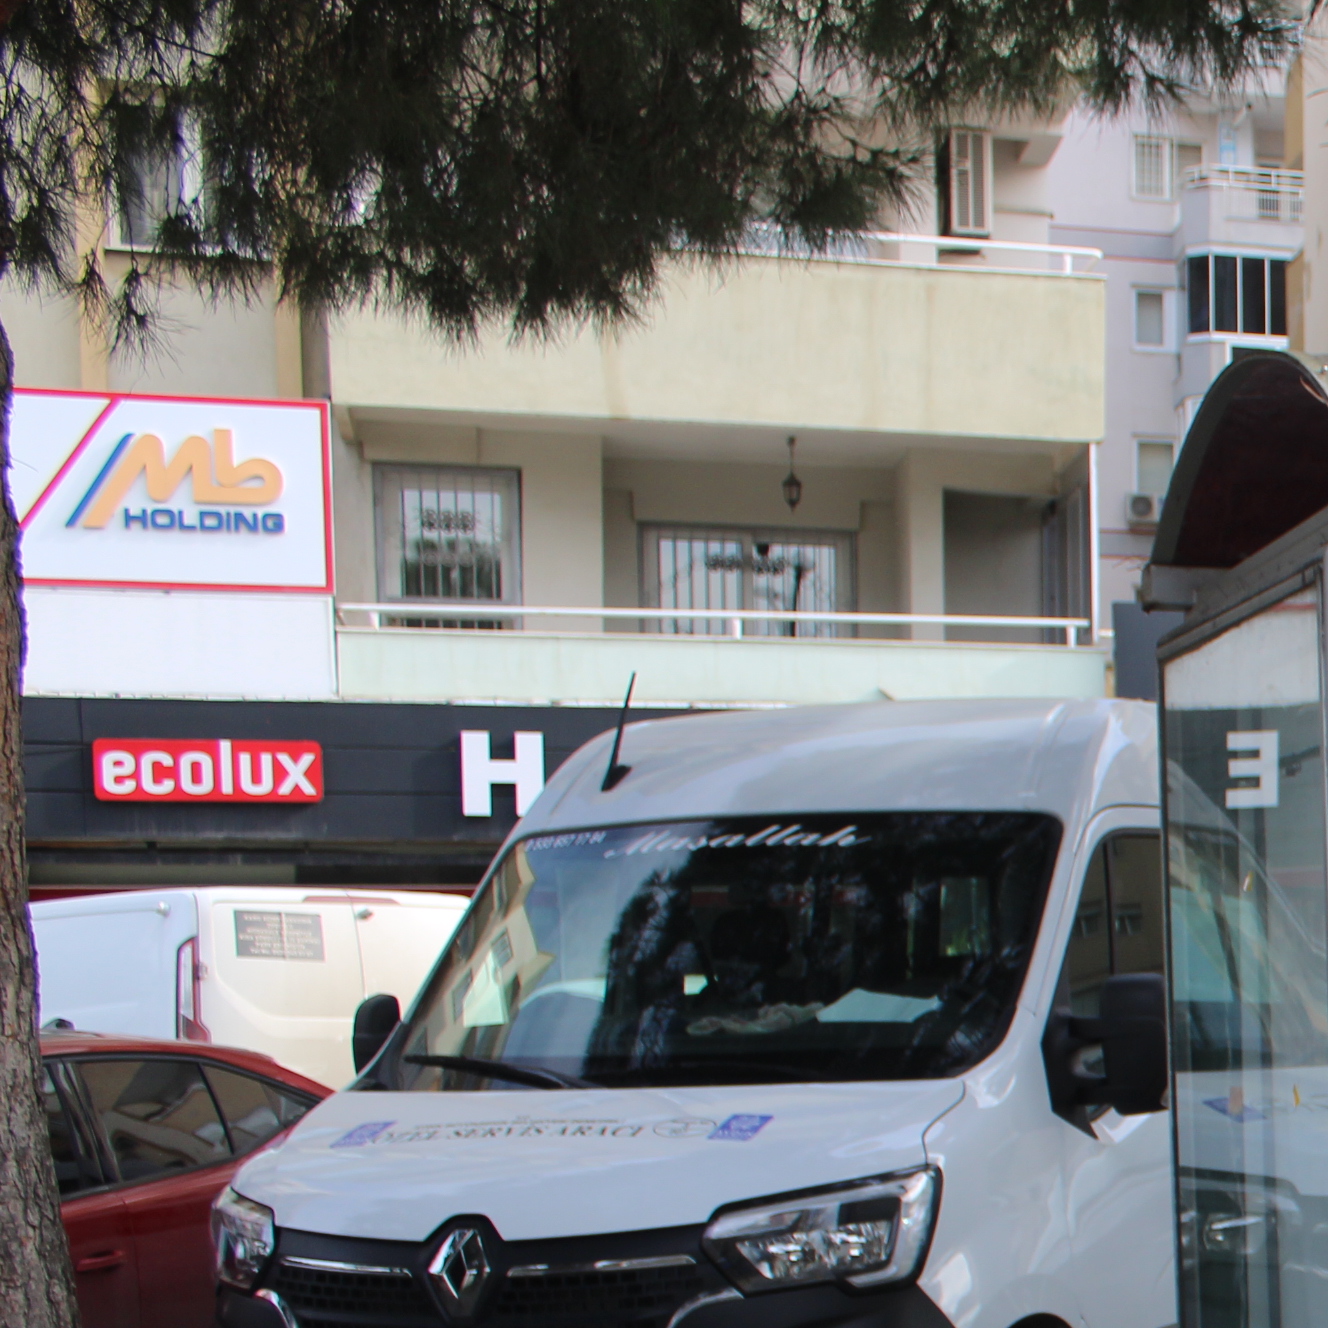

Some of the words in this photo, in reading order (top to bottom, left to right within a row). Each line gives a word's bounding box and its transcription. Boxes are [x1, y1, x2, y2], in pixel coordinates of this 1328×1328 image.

[123, 508, 285, 533] HOLDING
[102, 739, 317, 796] ecolux
[461, 730, 545, 817] H
